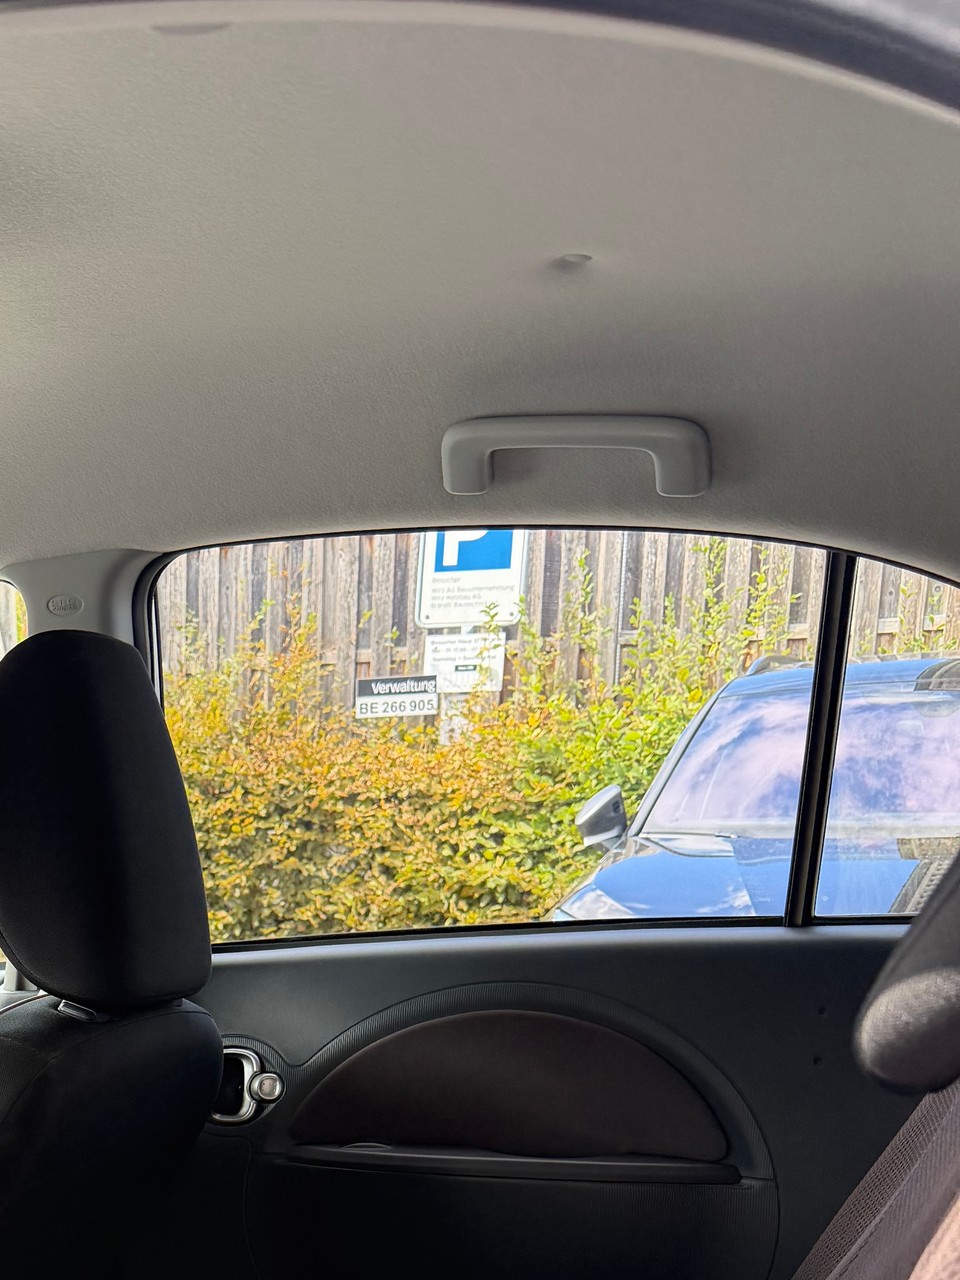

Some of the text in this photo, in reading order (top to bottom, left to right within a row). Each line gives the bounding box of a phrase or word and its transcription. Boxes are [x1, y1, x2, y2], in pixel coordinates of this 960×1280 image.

[371, 679, 436, 694] Verwaltung
[359, 702, 379, 715] BE
[382, 701, 407, 713] 266
[409, 699, 434, 712] 905
